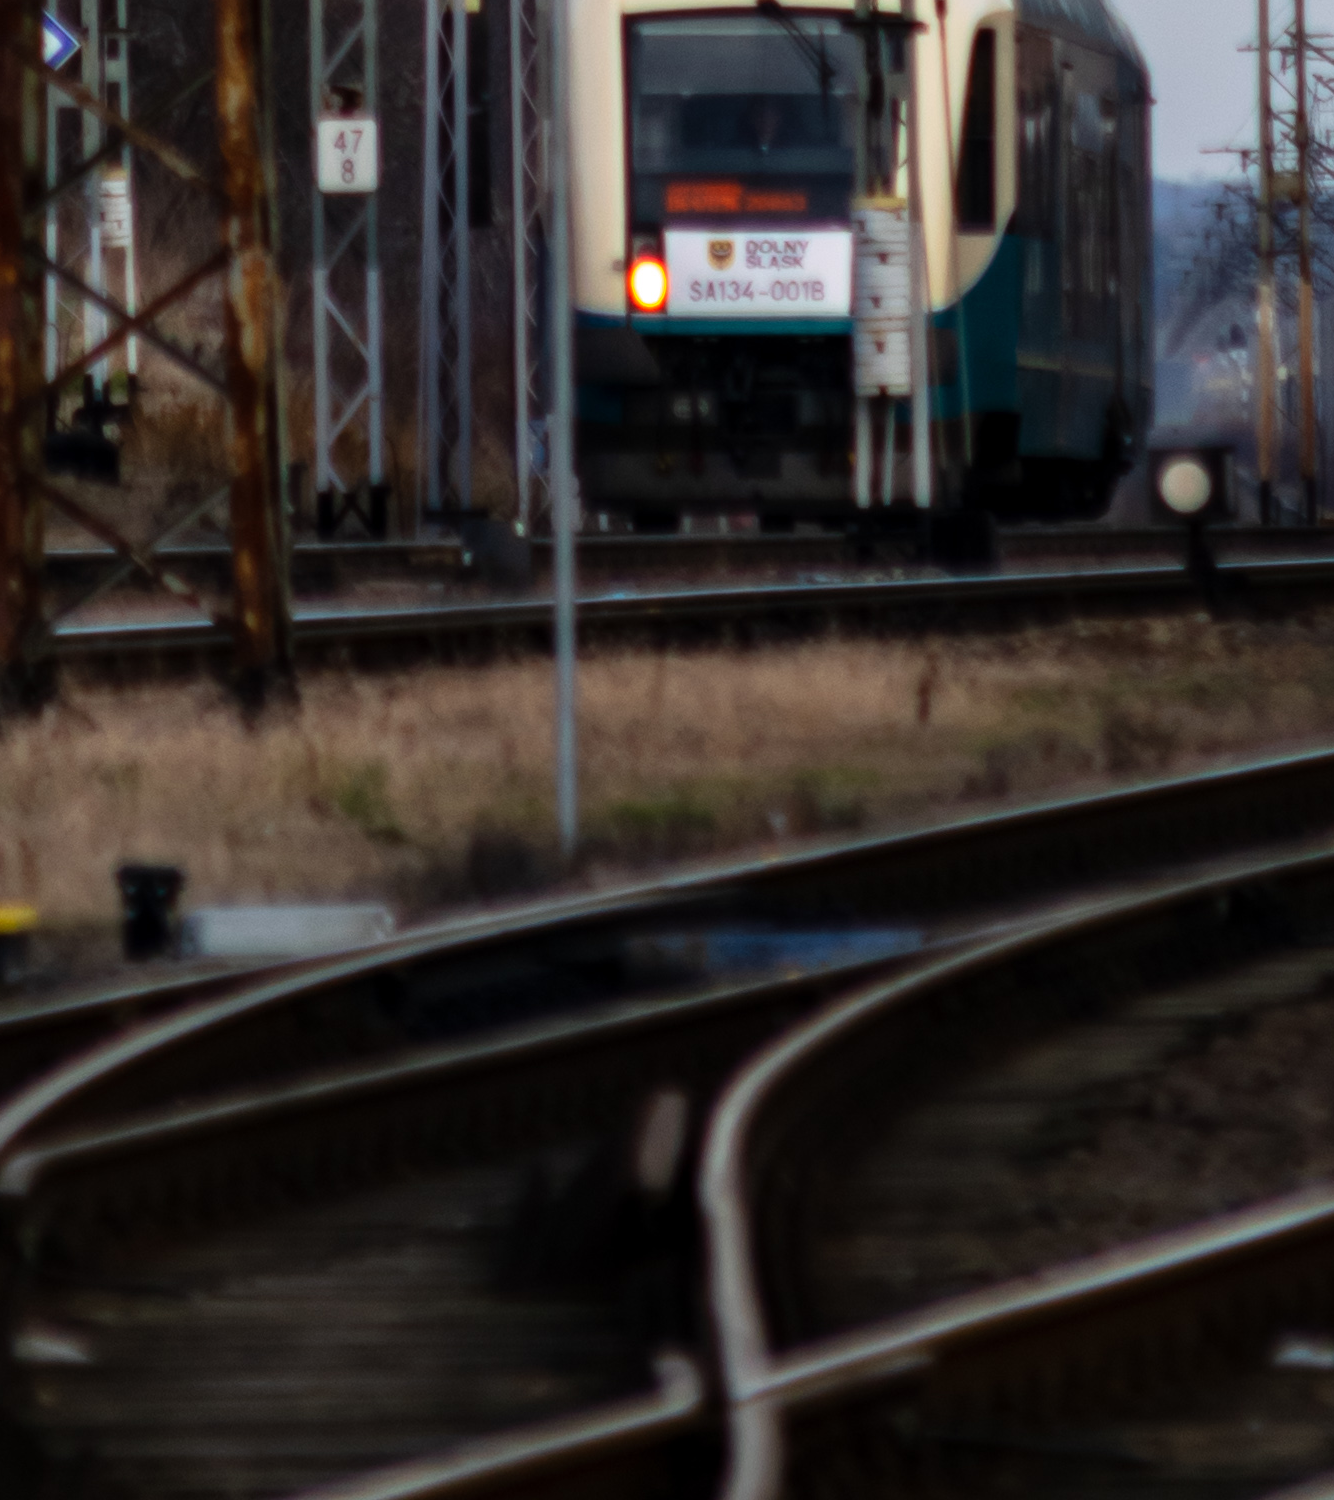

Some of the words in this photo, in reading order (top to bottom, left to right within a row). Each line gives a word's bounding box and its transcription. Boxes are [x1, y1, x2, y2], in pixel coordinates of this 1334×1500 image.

[334, 128, 363, 154] 47
[341, 158, 355, 183] 8
[745, 239, 809, 254] DOLNY
[689, 279, 826, 302] SA134-001B
